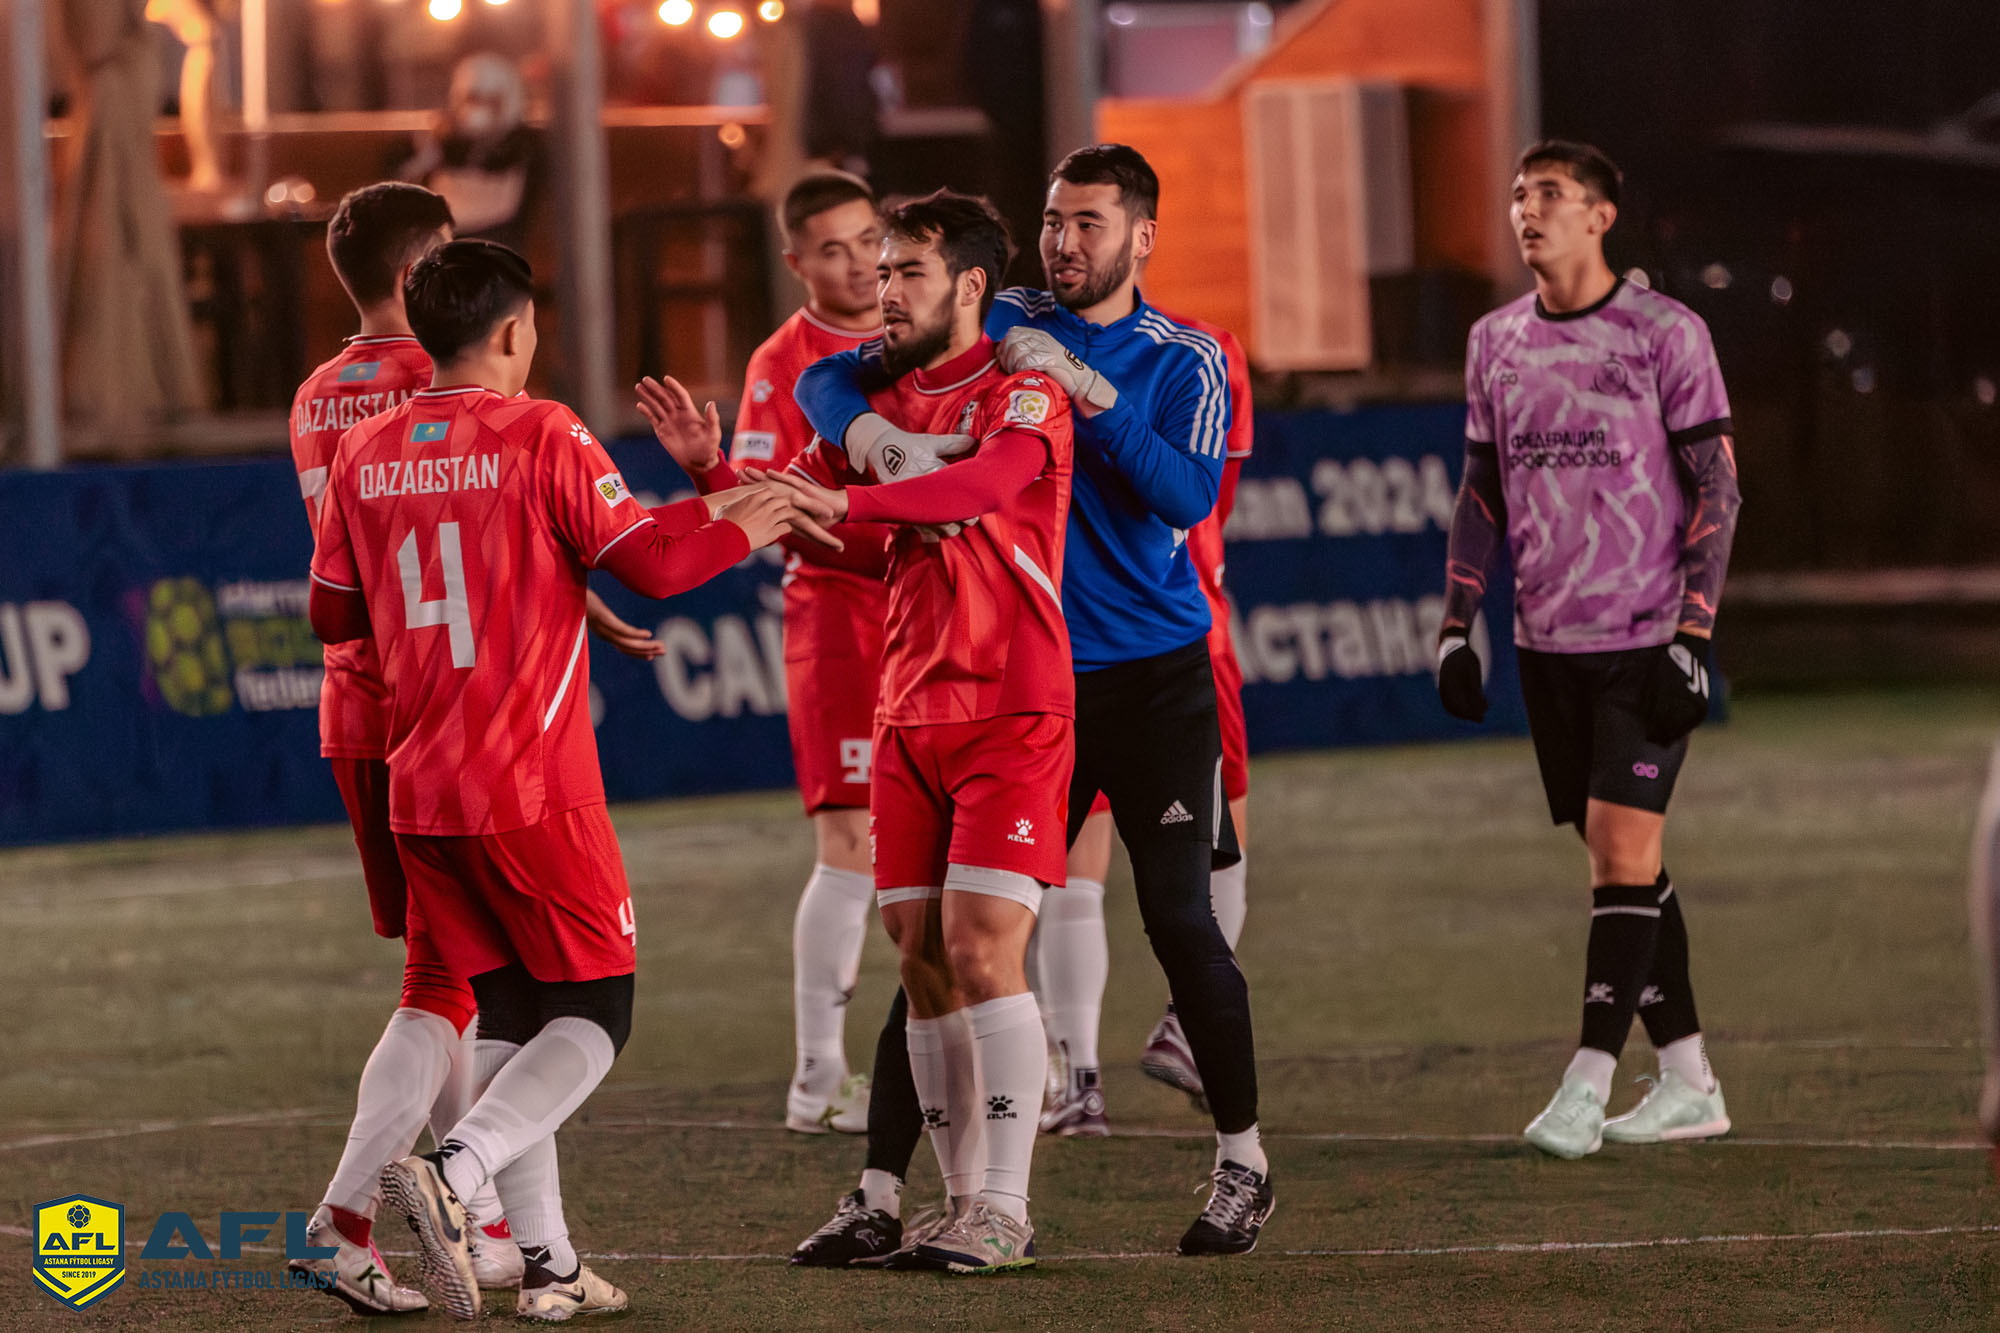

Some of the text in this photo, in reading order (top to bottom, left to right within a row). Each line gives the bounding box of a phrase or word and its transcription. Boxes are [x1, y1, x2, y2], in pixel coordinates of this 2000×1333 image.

[1511, 431, 1605, 449] ФЕДЕРАЦИЯ
[1504, 450, 1621, 470] РОФСОЮЗОВ
[360, 453, 500, 500] QAZAQSTAN
[397, 521, 476, 669] 4
[1160, 814, 1194, 825] adidas
[1007, 834, 1036, 846] KELME
[618, 897, 637, 948] 4
